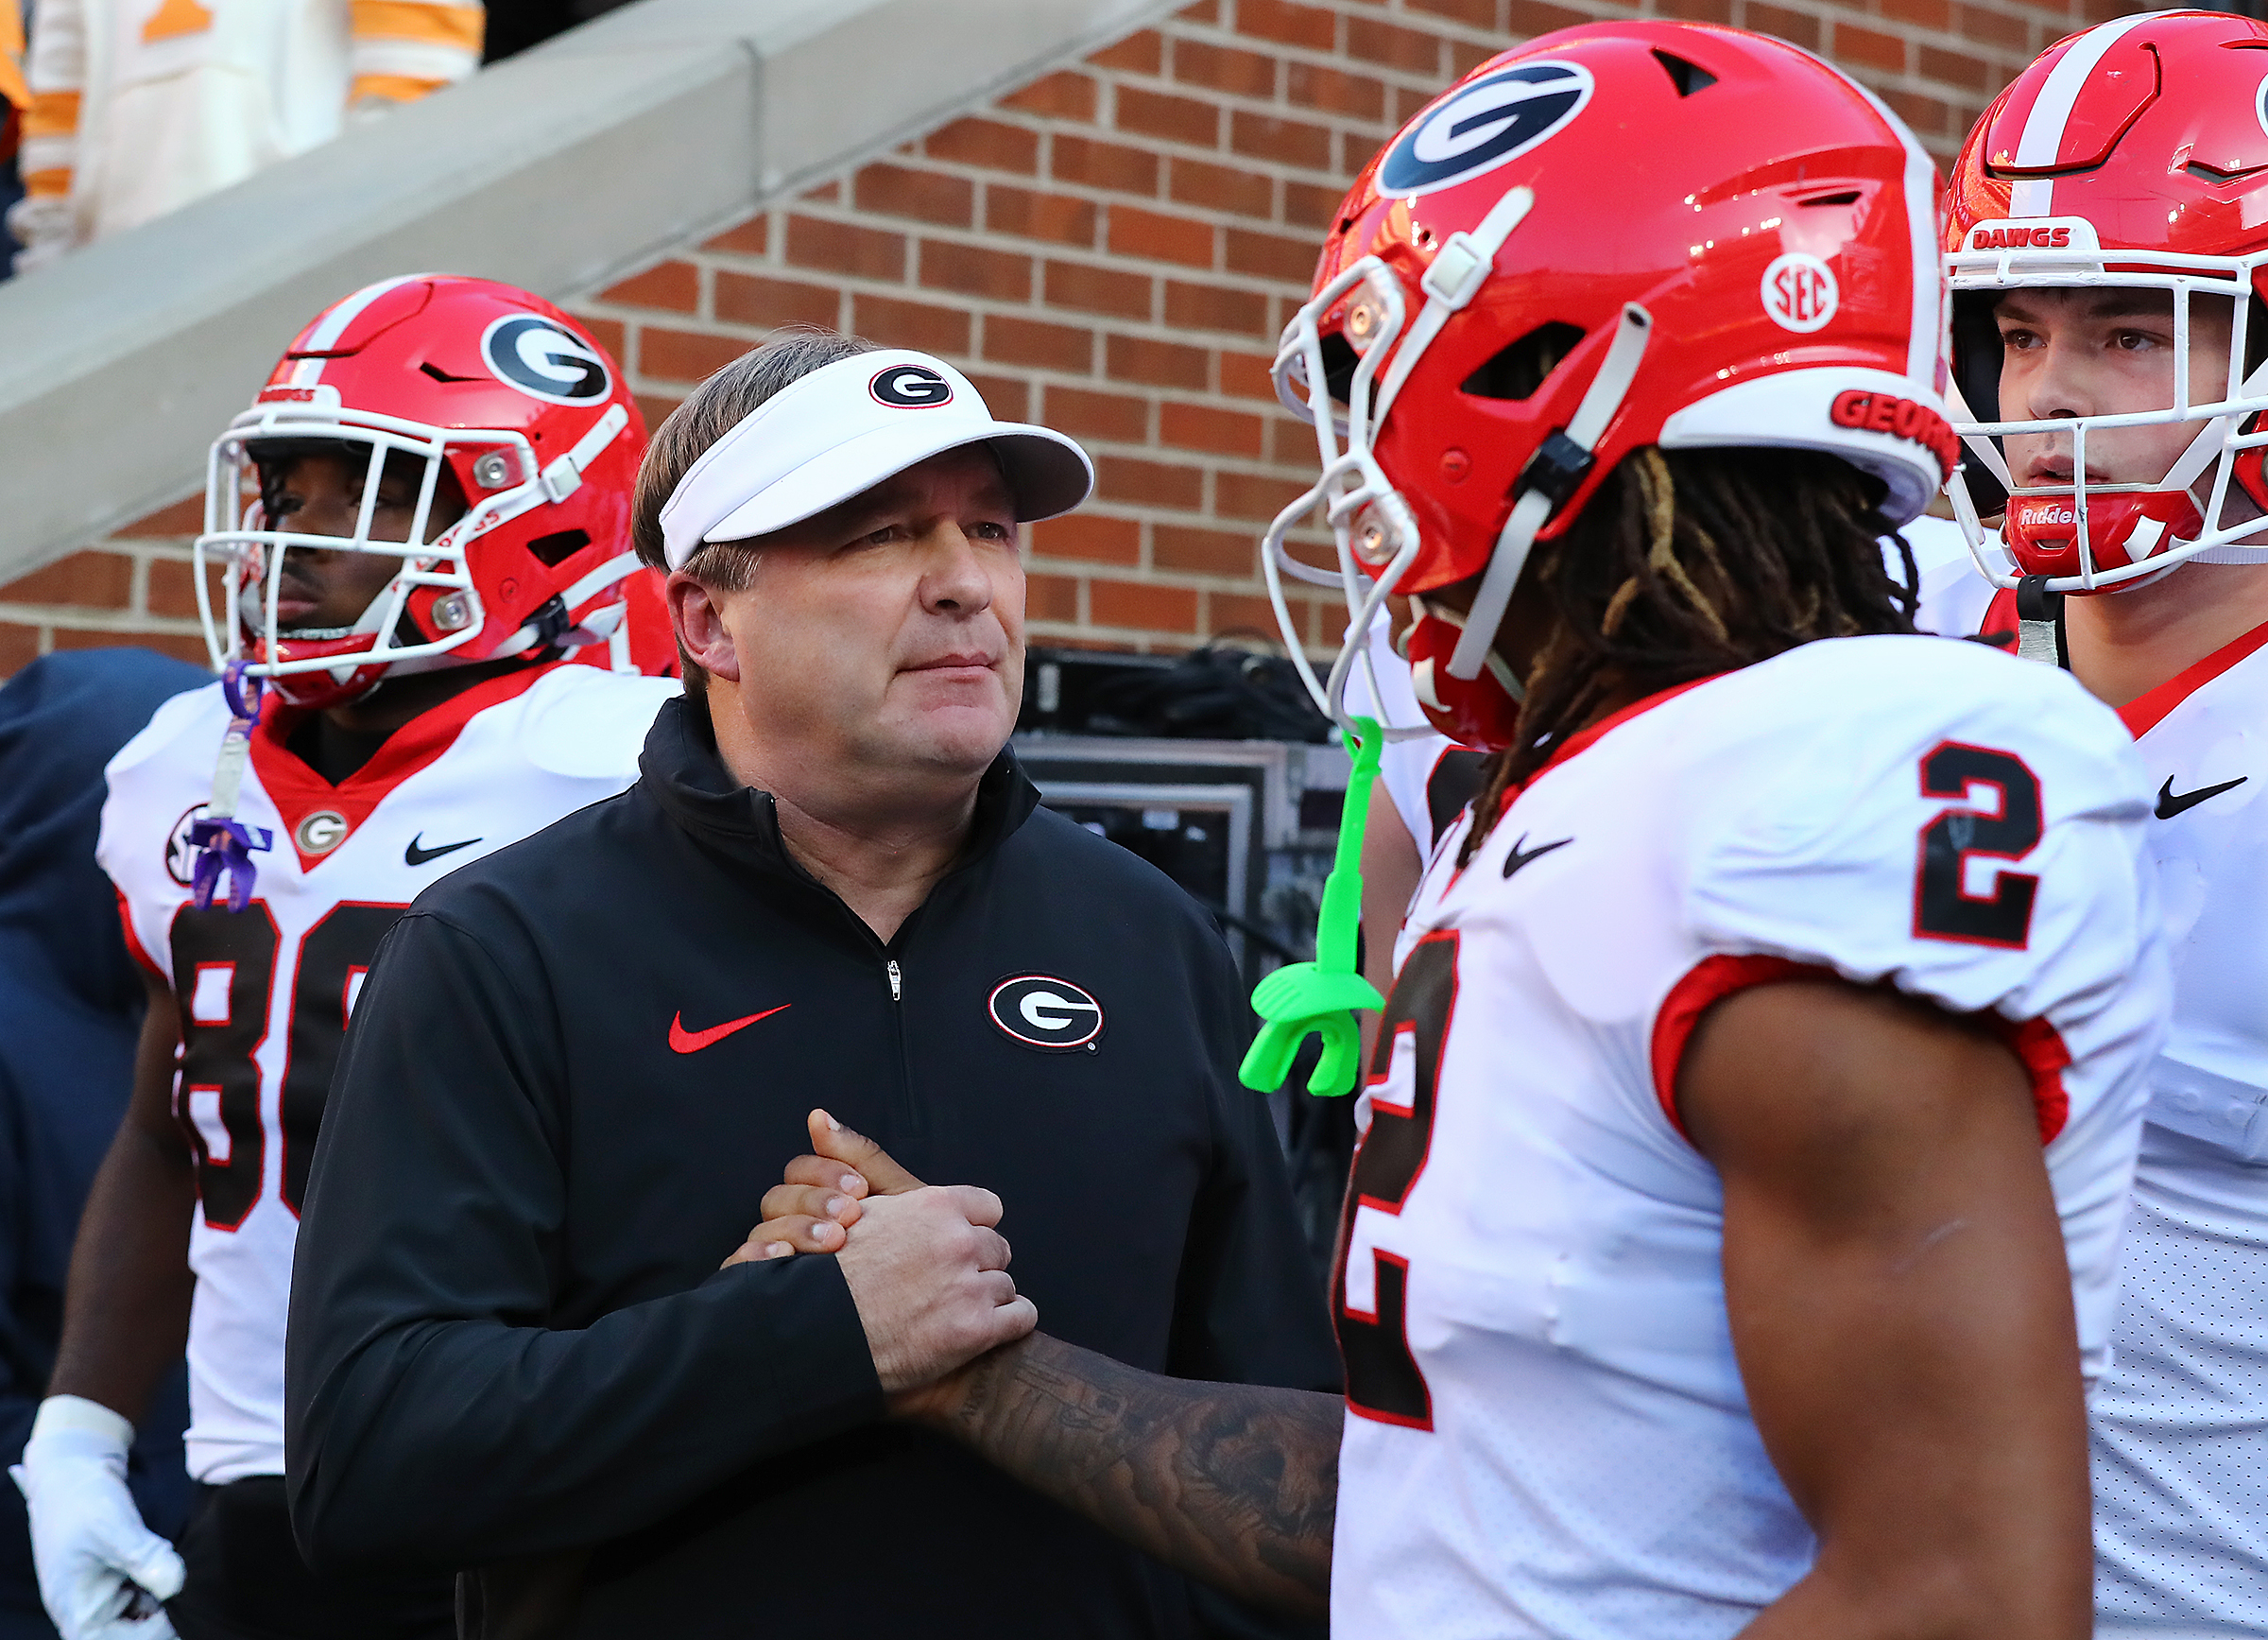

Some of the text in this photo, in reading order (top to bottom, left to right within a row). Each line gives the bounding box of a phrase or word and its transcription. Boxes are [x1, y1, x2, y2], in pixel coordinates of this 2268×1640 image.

[1381, 65, 1584, 192] G
[1972, 227, 2071, 250] DAWGS
[1773, 264, 1828, 321] SEC
[489, 318, 608, 399] G
[872, 366, 950, 406] G
[2020, 506, 2088, 526] Ridde
[297, 811, 349, 853] G
[1912, 739, 2047, 952] 2
[992, 978, 1100, 1044] G
[1326, 928, 1462, 1433] 2
